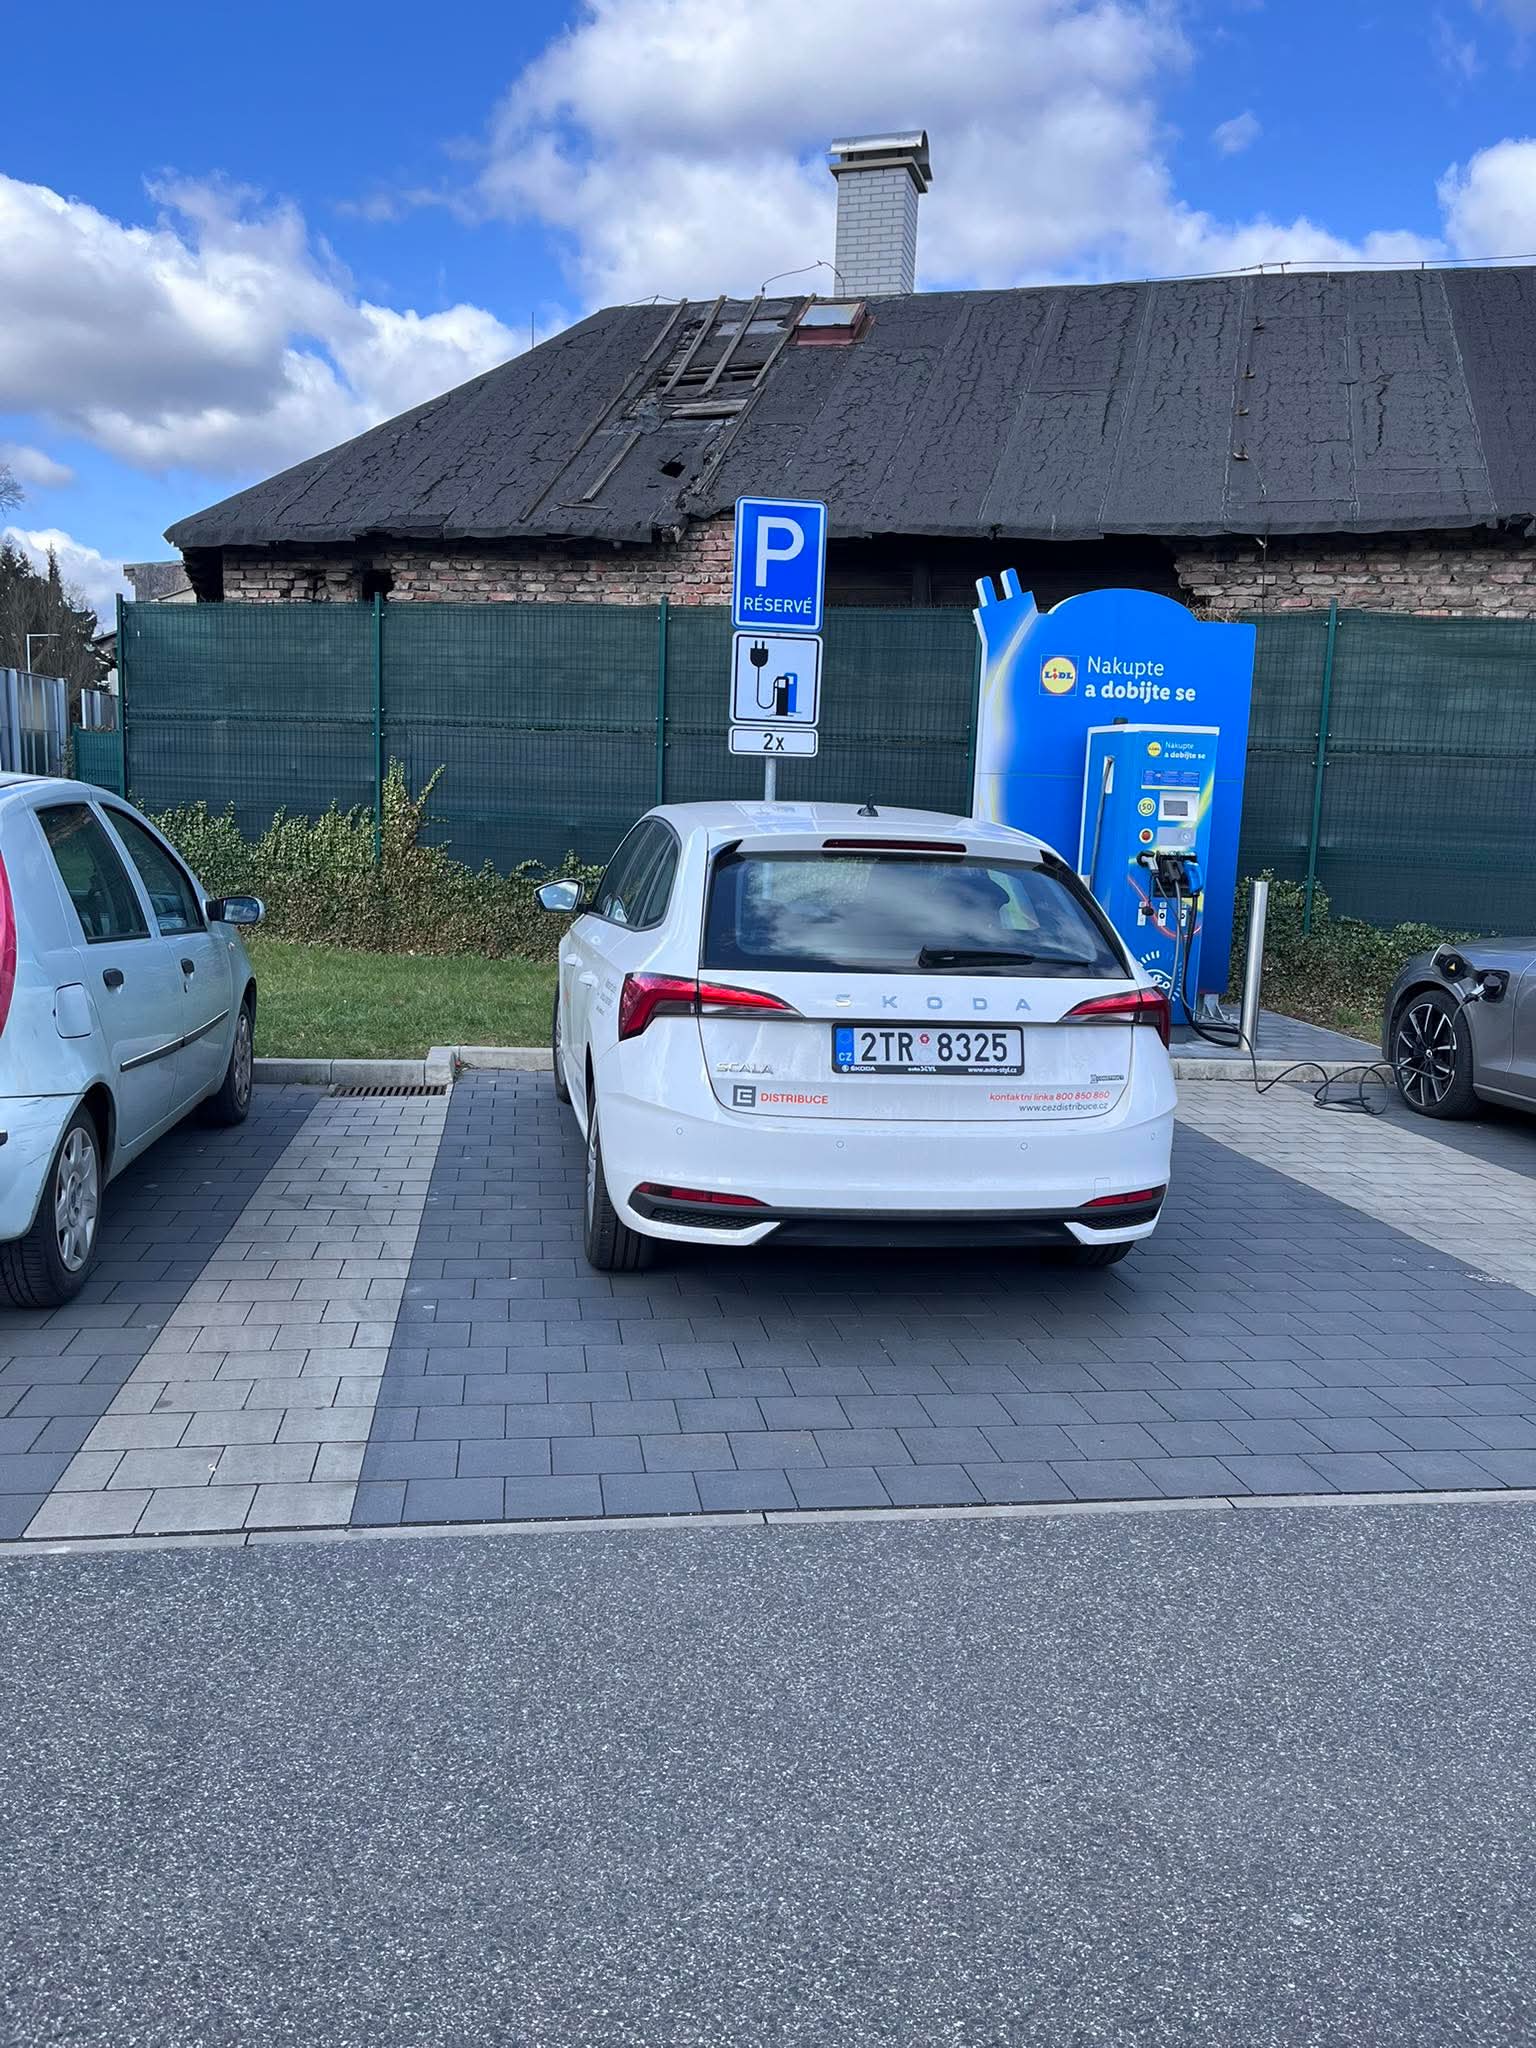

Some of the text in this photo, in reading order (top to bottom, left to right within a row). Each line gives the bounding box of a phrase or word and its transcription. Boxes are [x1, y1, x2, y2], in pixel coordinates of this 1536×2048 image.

[755, 515, 805, 588] P
[743, 594, 812, 615] RÉSERVÉ
[1087, 656, 1165, 680] Nakupte
[1084, 681, 1197, 704] a dobijte se
[763, 732, 785, 752] 2x
[1165, 741, 1194, 750] Nakupte
[1170, 751, 1197, 760] dobijte
[860, 1032, 1008, 1063] 2TR 8325
[838, 1052, 852, 1062] CZ
[716, 1063, 774, 1075] SCALA
[760, 1092, 829, 1105] DISTRIBUCE
[1034, 1093, 1054, 1101] linka
[1055, 1092, 1074, 1101] 800
[1018, 1102, 1109, 1112] www.cezdistribuce.cz
